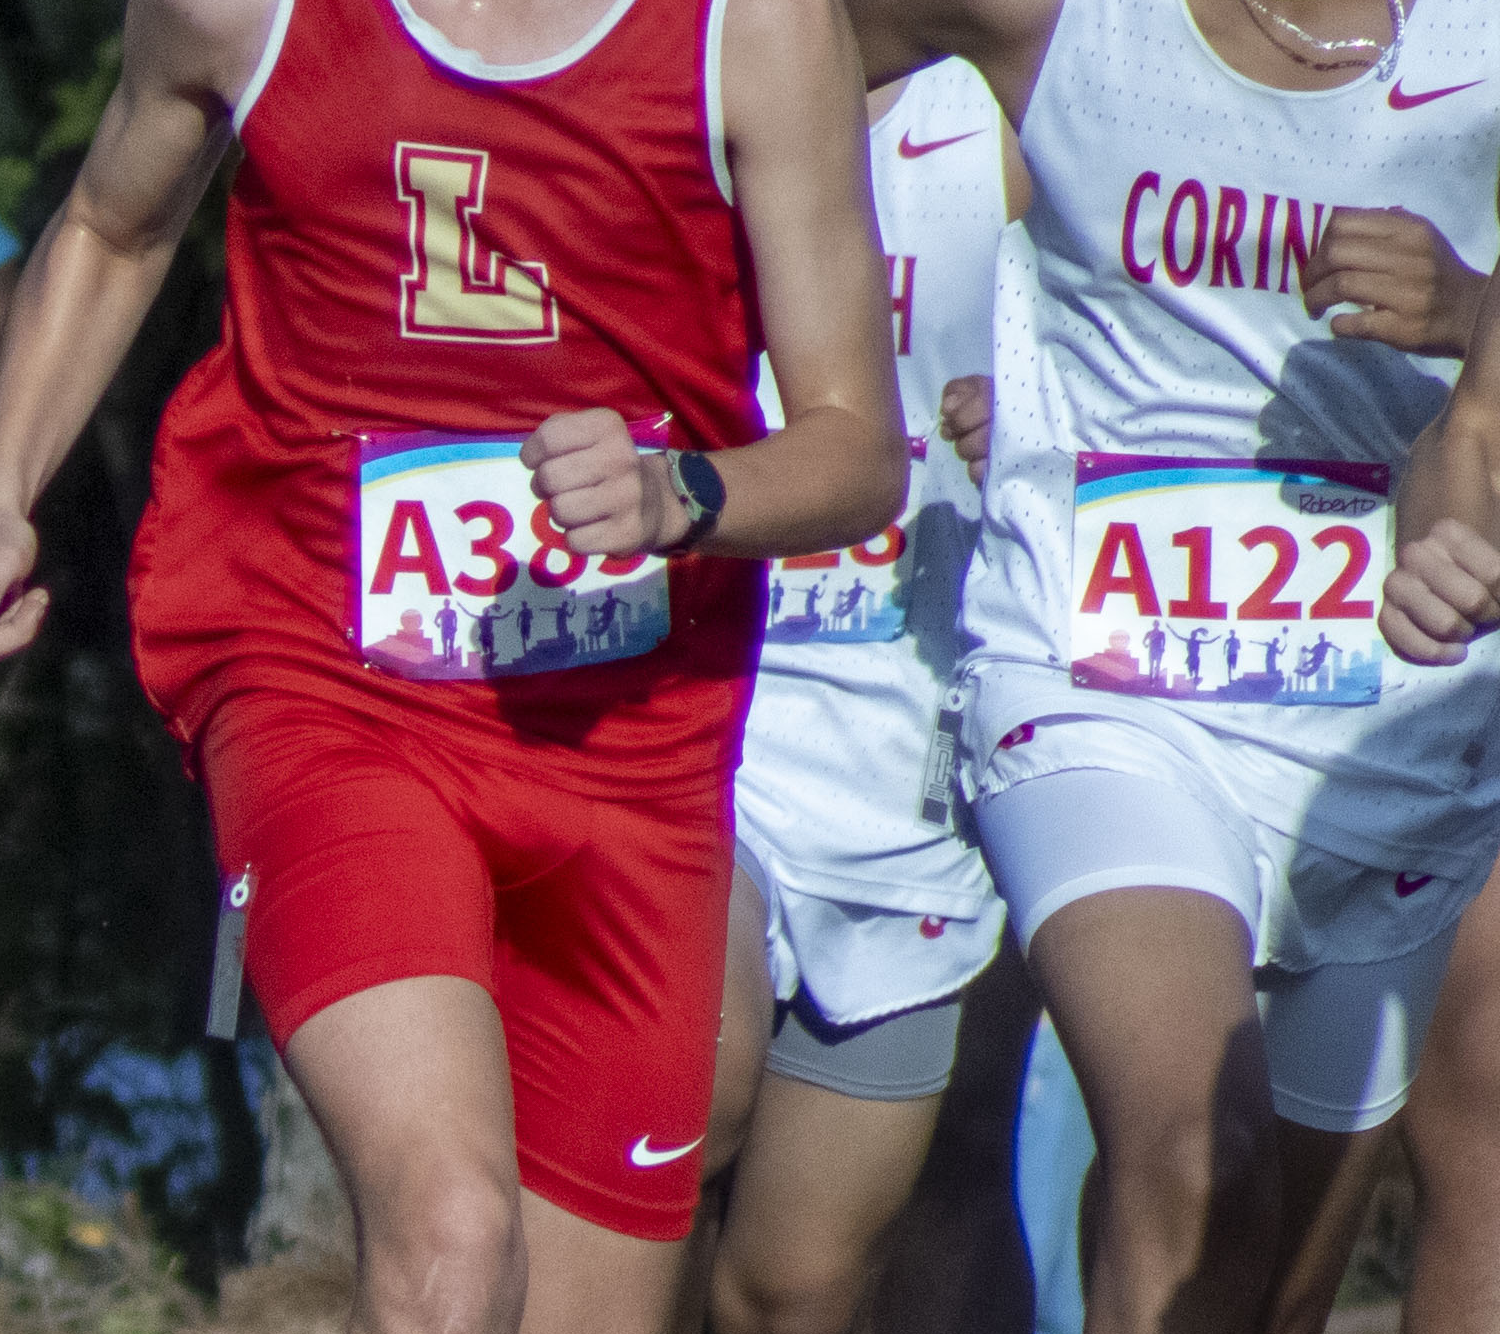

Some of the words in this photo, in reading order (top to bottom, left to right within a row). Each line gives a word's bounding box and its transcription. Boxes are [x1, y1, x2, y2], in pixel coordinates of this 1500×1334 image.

[396, 141, 559, 343] L
[1121, 170, 1340, 294] CORIN
[369, 500, 649, 597] A38
[1079, 522, 1375, 620] A122
